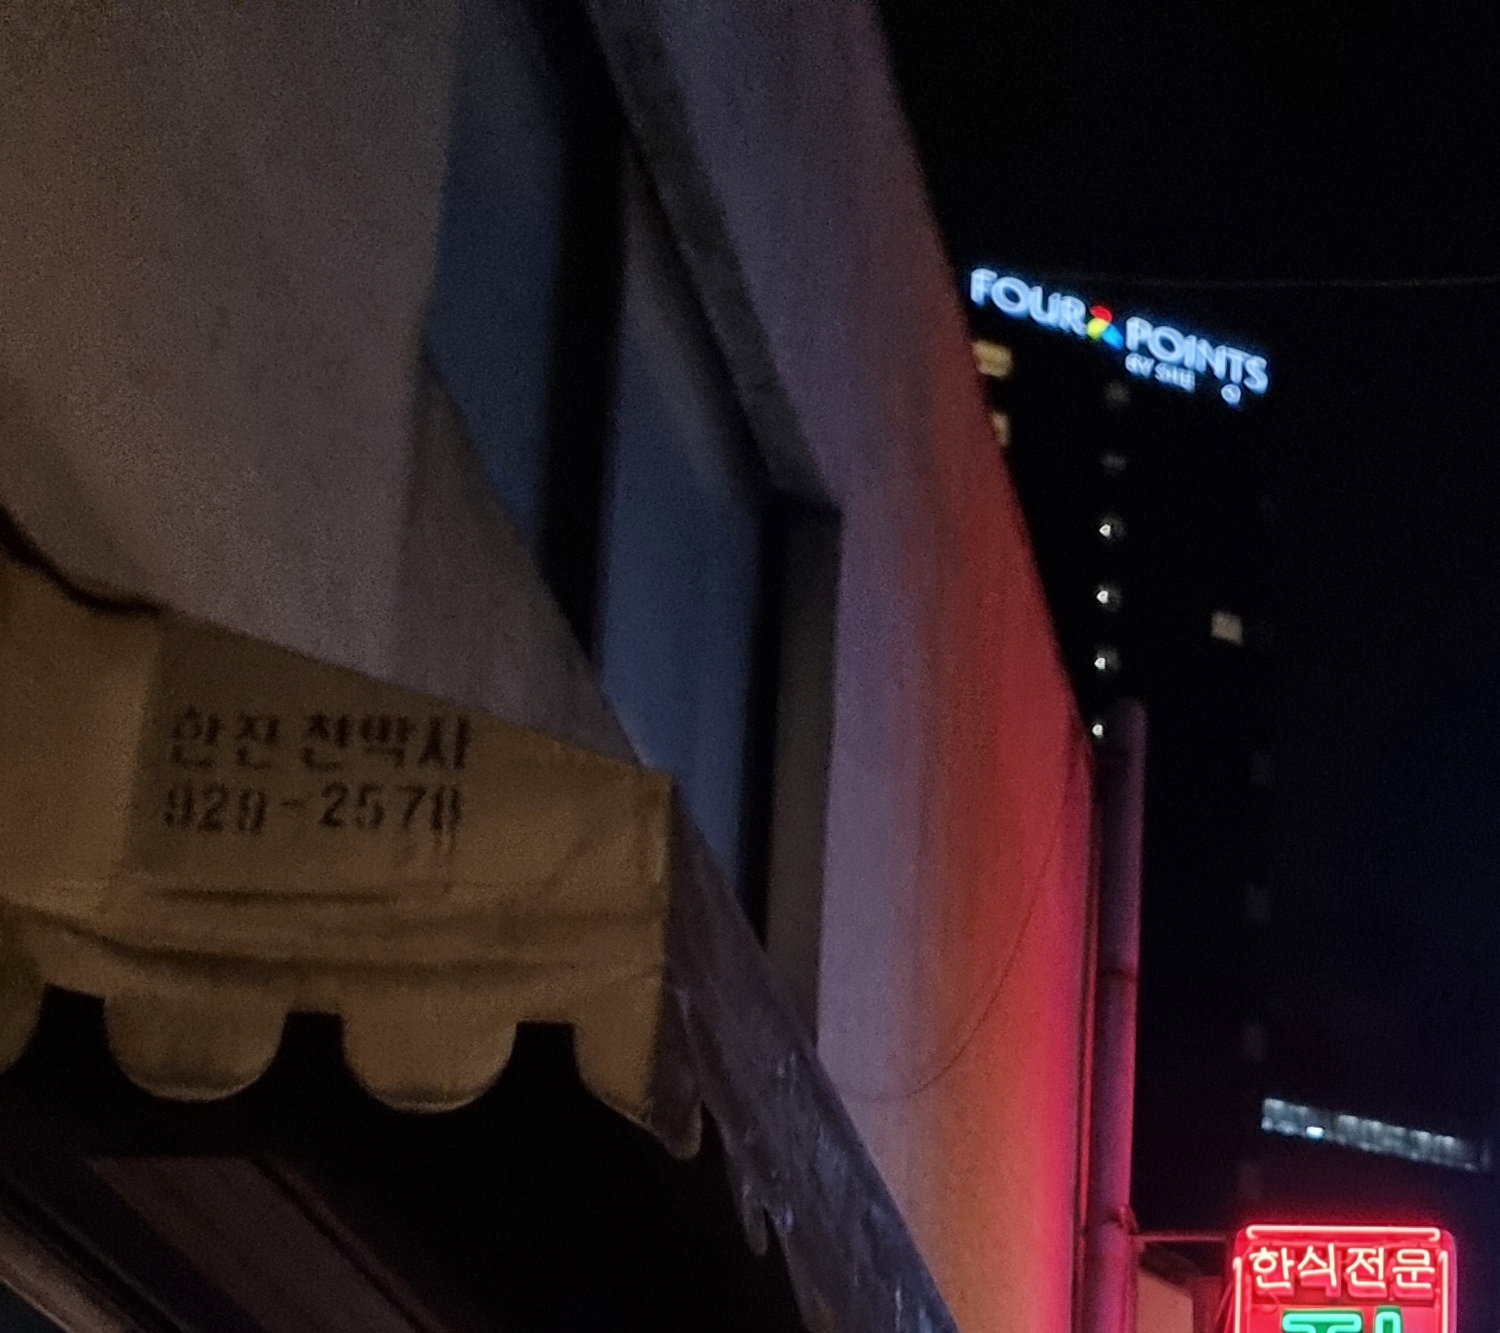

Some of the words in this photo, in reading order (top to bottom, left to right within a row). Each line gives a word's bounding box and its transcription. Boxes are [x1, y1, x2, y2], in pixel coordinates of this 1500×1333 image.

[969, 267, 1089, 339] FOUR
[1125, 315, 1269, 395] POINTS
[1249, 1242, 1437, 1290] 한식전문
